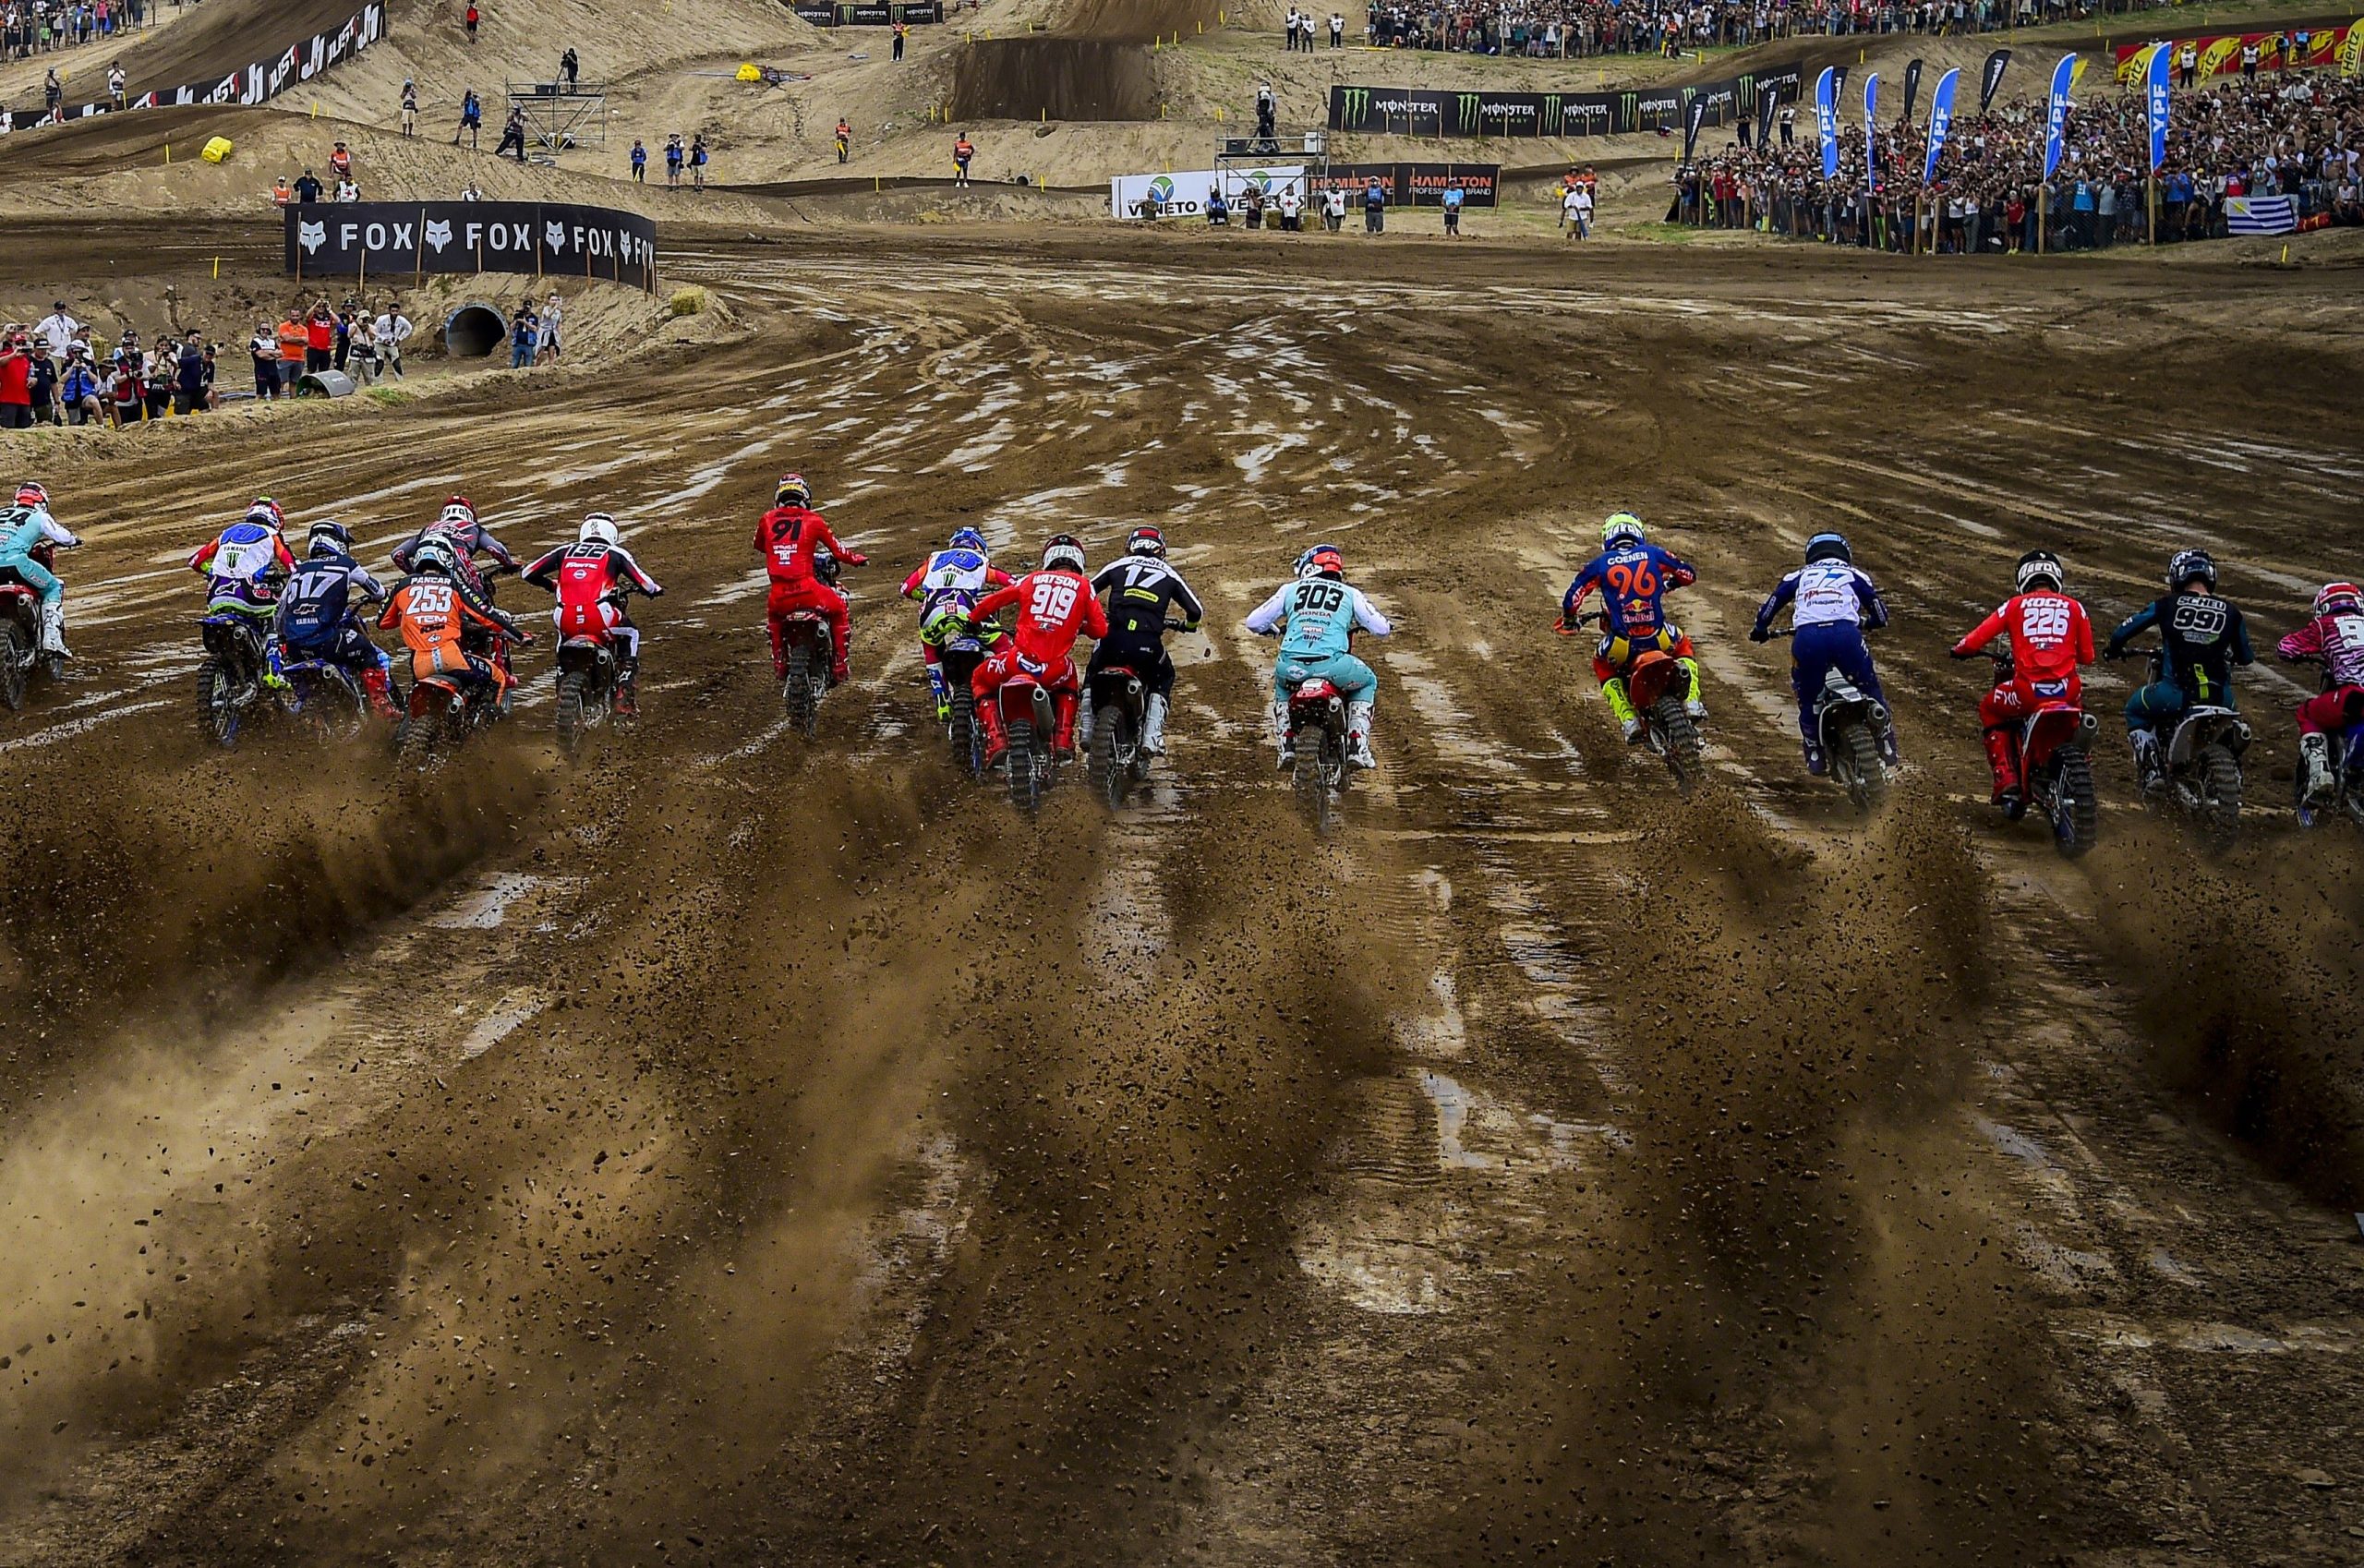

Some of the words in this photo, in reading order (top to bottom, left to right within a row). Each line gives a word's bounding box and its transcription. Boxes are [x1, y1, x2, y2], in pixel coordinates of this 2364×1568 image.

[2343, 30, 2359, 72] Hertz
[2129, 58, 2144, 92] ertz
[1481, 102, 1535, 117] MONSTER
[1563, 103, 1608, 117] MONSTER
[1639, 99, 1677, 113] MONSTER
[2050, 93, 2067, 141] YPF
[2153, 84, 2165, 134] YPF
[1821, 103, 1833, 149] YPF
[1931, 106, 1949, 153] YPF
[341, 223, 413, 251] FOX
[466, 223, 531, 251] FOX
[573, 226, 613, 258] FOX
[634, 236, 654, 270] FOX
[772, 519, 802, 542] 91
[566, 544, 609, 558] 132
[1607, 551, 1648, 565] COENEN
[1032, 573, 1080, 590] WATSON
[1124, 564, 1167, 588] 17
[1607, 561, 1657, 597] 96
[406, 585, 452, 615] 253
[1031, 585, 1077, 620] 919
[1294, 585, 1344, 612] 303
[2020, 597, 2069, 608] KOCH
[2177, 596, 2226, 611] SCHEU
[1299, 610, 1332, 619] HONDA
[2022, 609, 2069, 636] 226
[2173, 606, 2226, 634] 991
